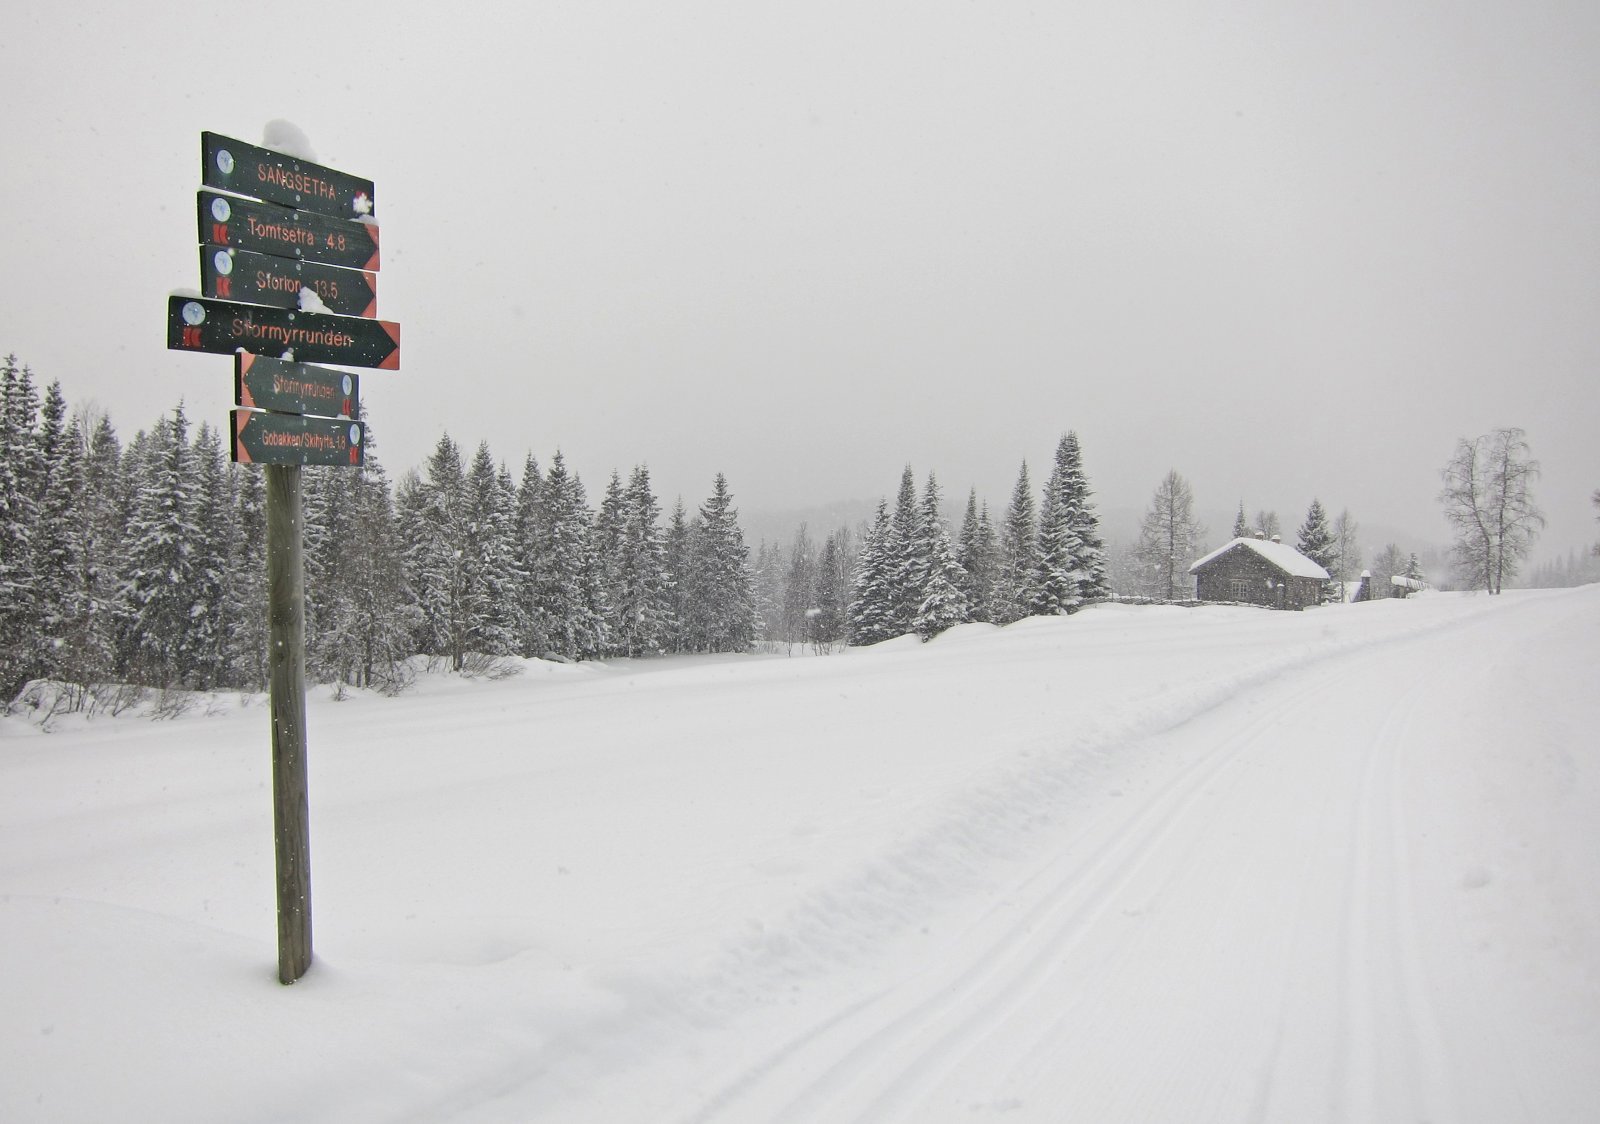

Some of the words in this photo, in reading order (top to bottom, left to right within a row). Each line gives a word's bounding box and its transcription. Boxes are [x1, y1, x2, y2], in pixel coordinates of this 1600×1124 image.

[248, 218, 314, 246] Tomtsetra
[326, 233, 346, 251] 4.8
[314, 279, 338, 299] 13.5
[232, 318, 352, 347] Stormyrrunden
